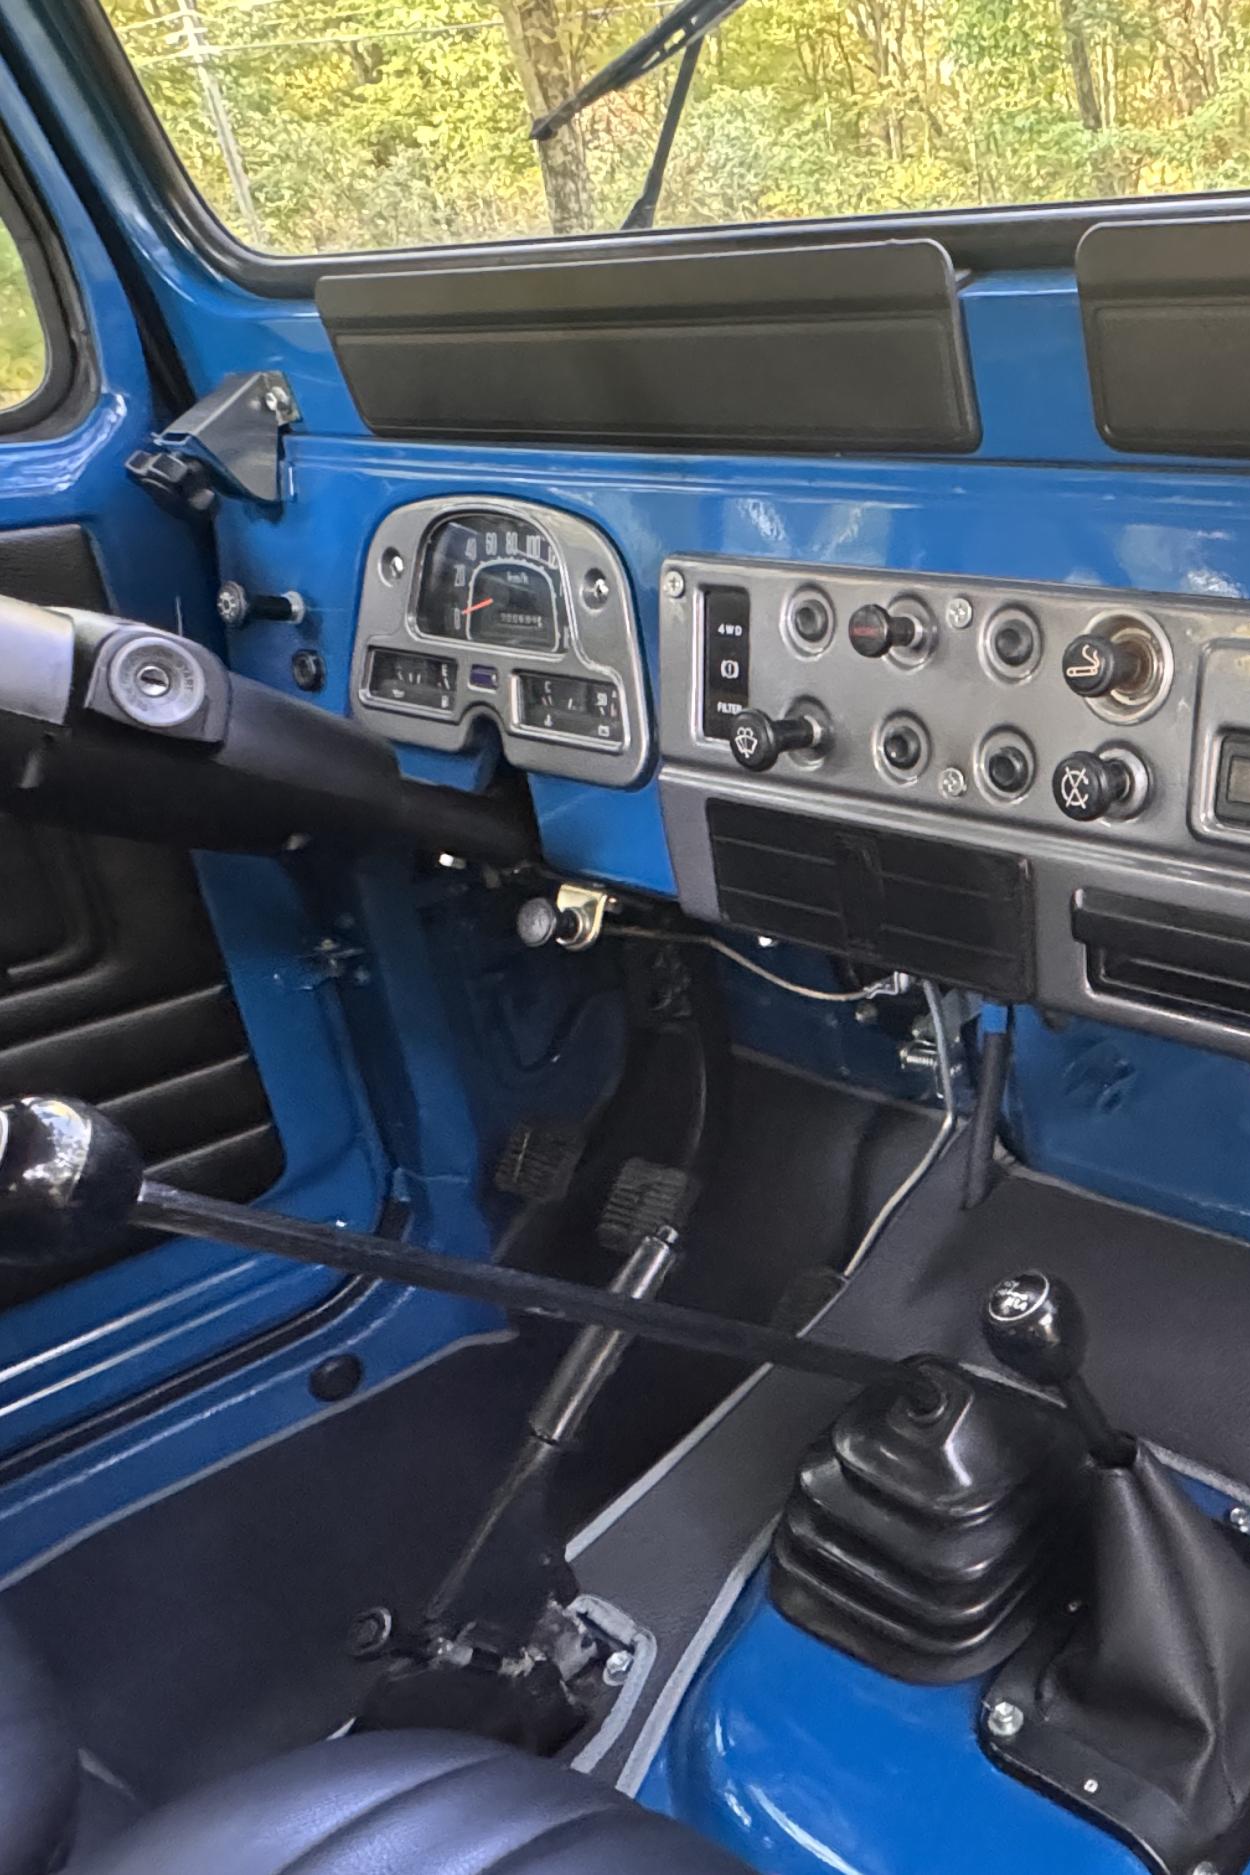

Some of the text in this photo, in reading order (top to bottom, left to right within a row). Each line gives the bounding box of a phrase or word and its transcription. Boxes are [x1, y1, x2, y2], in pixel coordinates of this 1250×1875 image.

[465, 537, 477, 561] 40
[485, 532, 498, 556] 60
[505, 531, 518, 555] 80
[526, 535, 541, 559] 100
[454, 564, 466, 587] 20
[506, 571, 529, 585] km/h
[453, 607, 461, 630] 0
[717, 623, 743, 636] 4WD
[717, 701, 743, 714] FILTER
